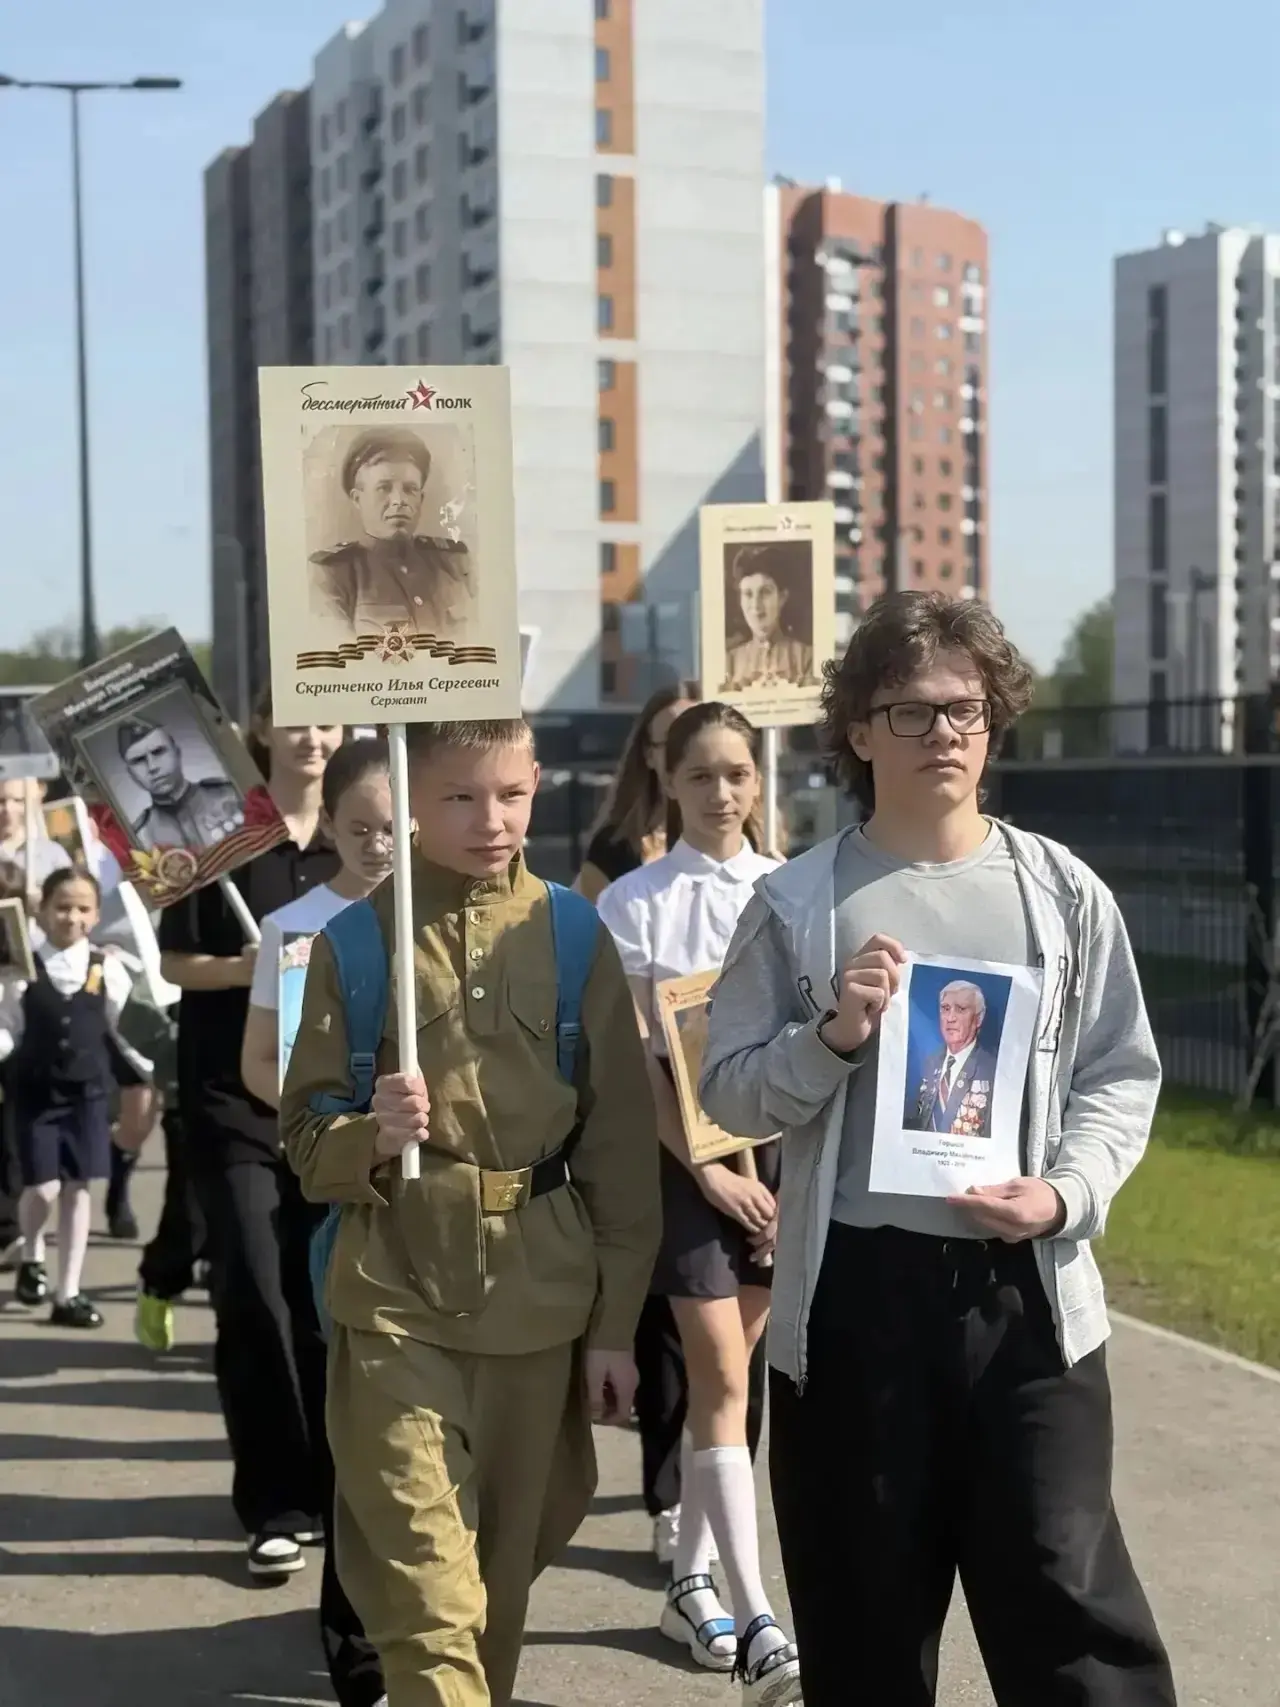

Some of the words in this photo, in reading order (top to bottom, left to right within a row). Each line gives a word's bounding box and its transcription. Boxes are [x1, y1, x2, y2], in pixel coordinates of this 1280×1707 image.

[295, 681, 383, 697] Скрипченко
[388, 679, 424, 692] Илья
[428, 677, 500, 693] Сергеевич
[370, 695, 428, 708] Сержант
